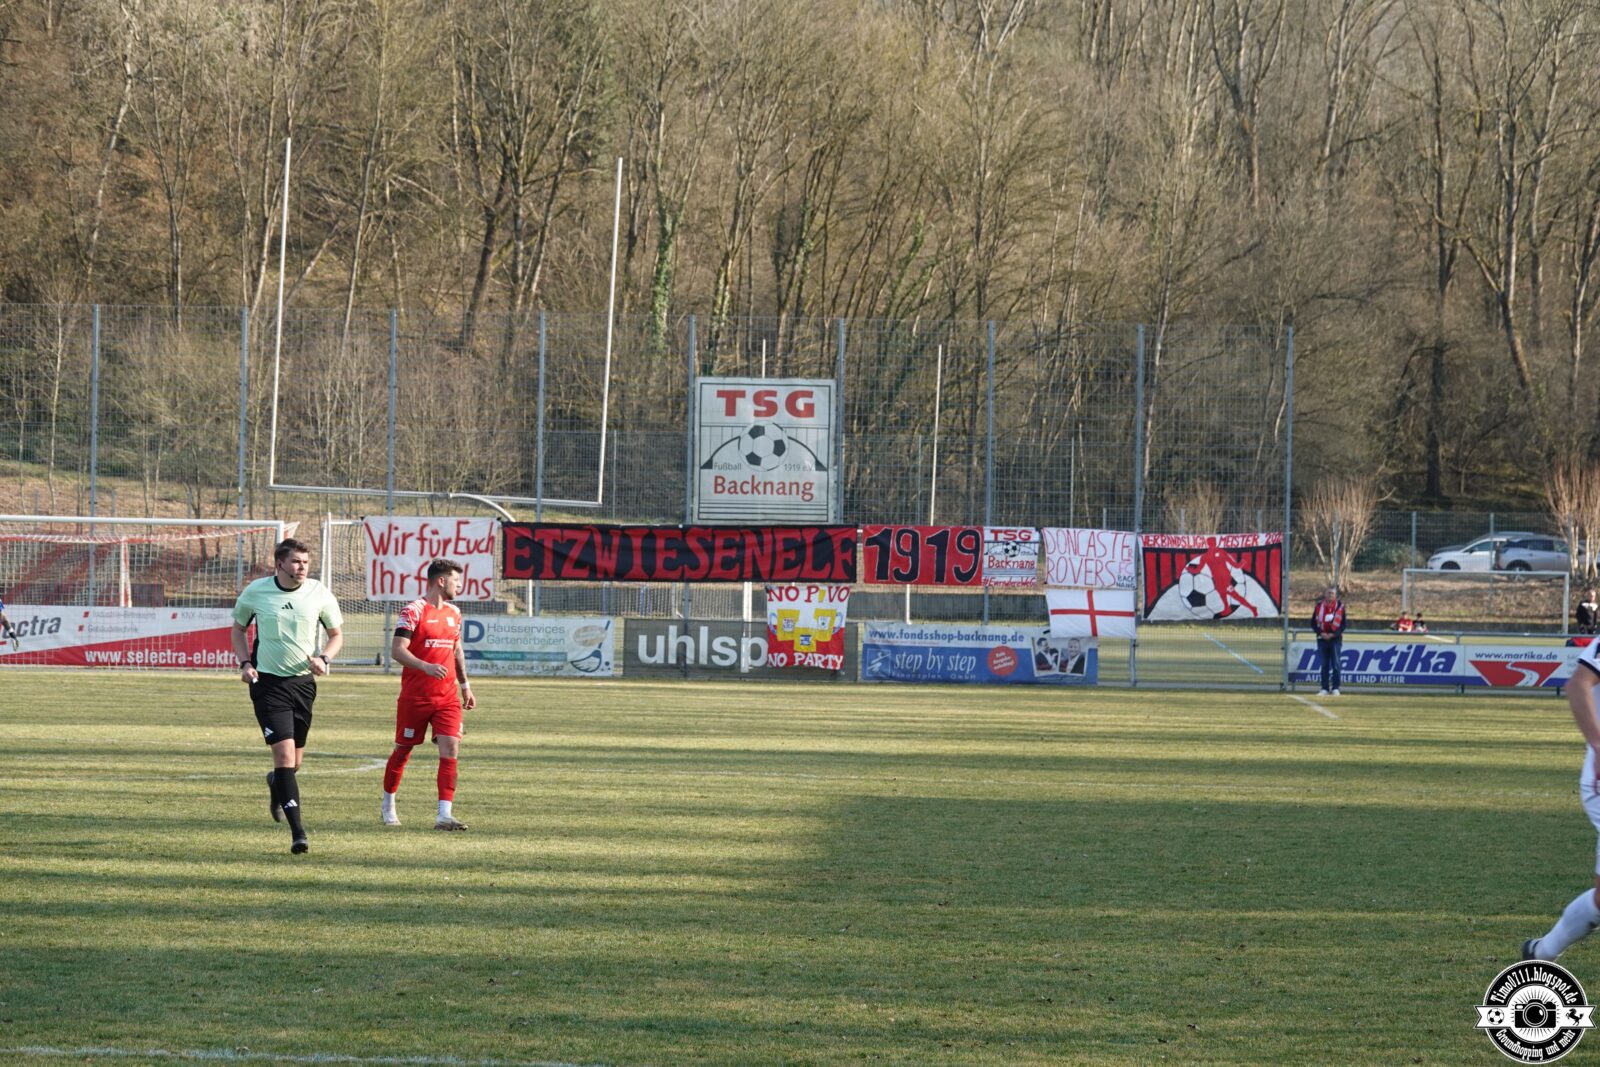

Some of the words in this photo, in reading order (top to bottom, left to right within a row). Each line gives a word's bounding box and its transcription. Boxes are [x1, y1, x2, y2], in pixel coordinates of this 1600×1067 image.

[716, 389, 815, 418] TSG
[713, 462, 742, 471] Fußball
[784, 463, 801, 472] 1919
[713, 474, 815, 502] Backnang
[364, 521, 413, 556] Wir
[415, 521, 453, 558] für
[453, 519, 495, 556] Euch
[990, 528, 1033, 541] TSG
[1217, 533, 1259, 548] MEISTER
[1041, 527, 1137, 561] DONCASTER
[864, 527, 982, 584] 1919
[371, 559, 413, 596] Ihr
[1045, 556, 1117, 588] ROVERS
[1118, 562, 1134, 575] FC
[768, 585, 800, 602] NO
[486, 622, 566, 635] Hausservices
[868, 627, 1025, 645] www.fondsshop-backnang.de
[486, 634, 566, 646] Gartenarbeiten
[85, 648, 240, 665] www.selectra-elektr
[767, 652, 788, 667] NO
[793, 652, 844, 670] PARTY
[894, 651, 923, 673] step
[926, 647, 944, 673] by
[947, 653, 977, 674] step
[1475, 650, 1558, 661] www.martika.de
[1355, 674, 1376, 684] UND
[1379, 674, 1406, 684] MEHR
